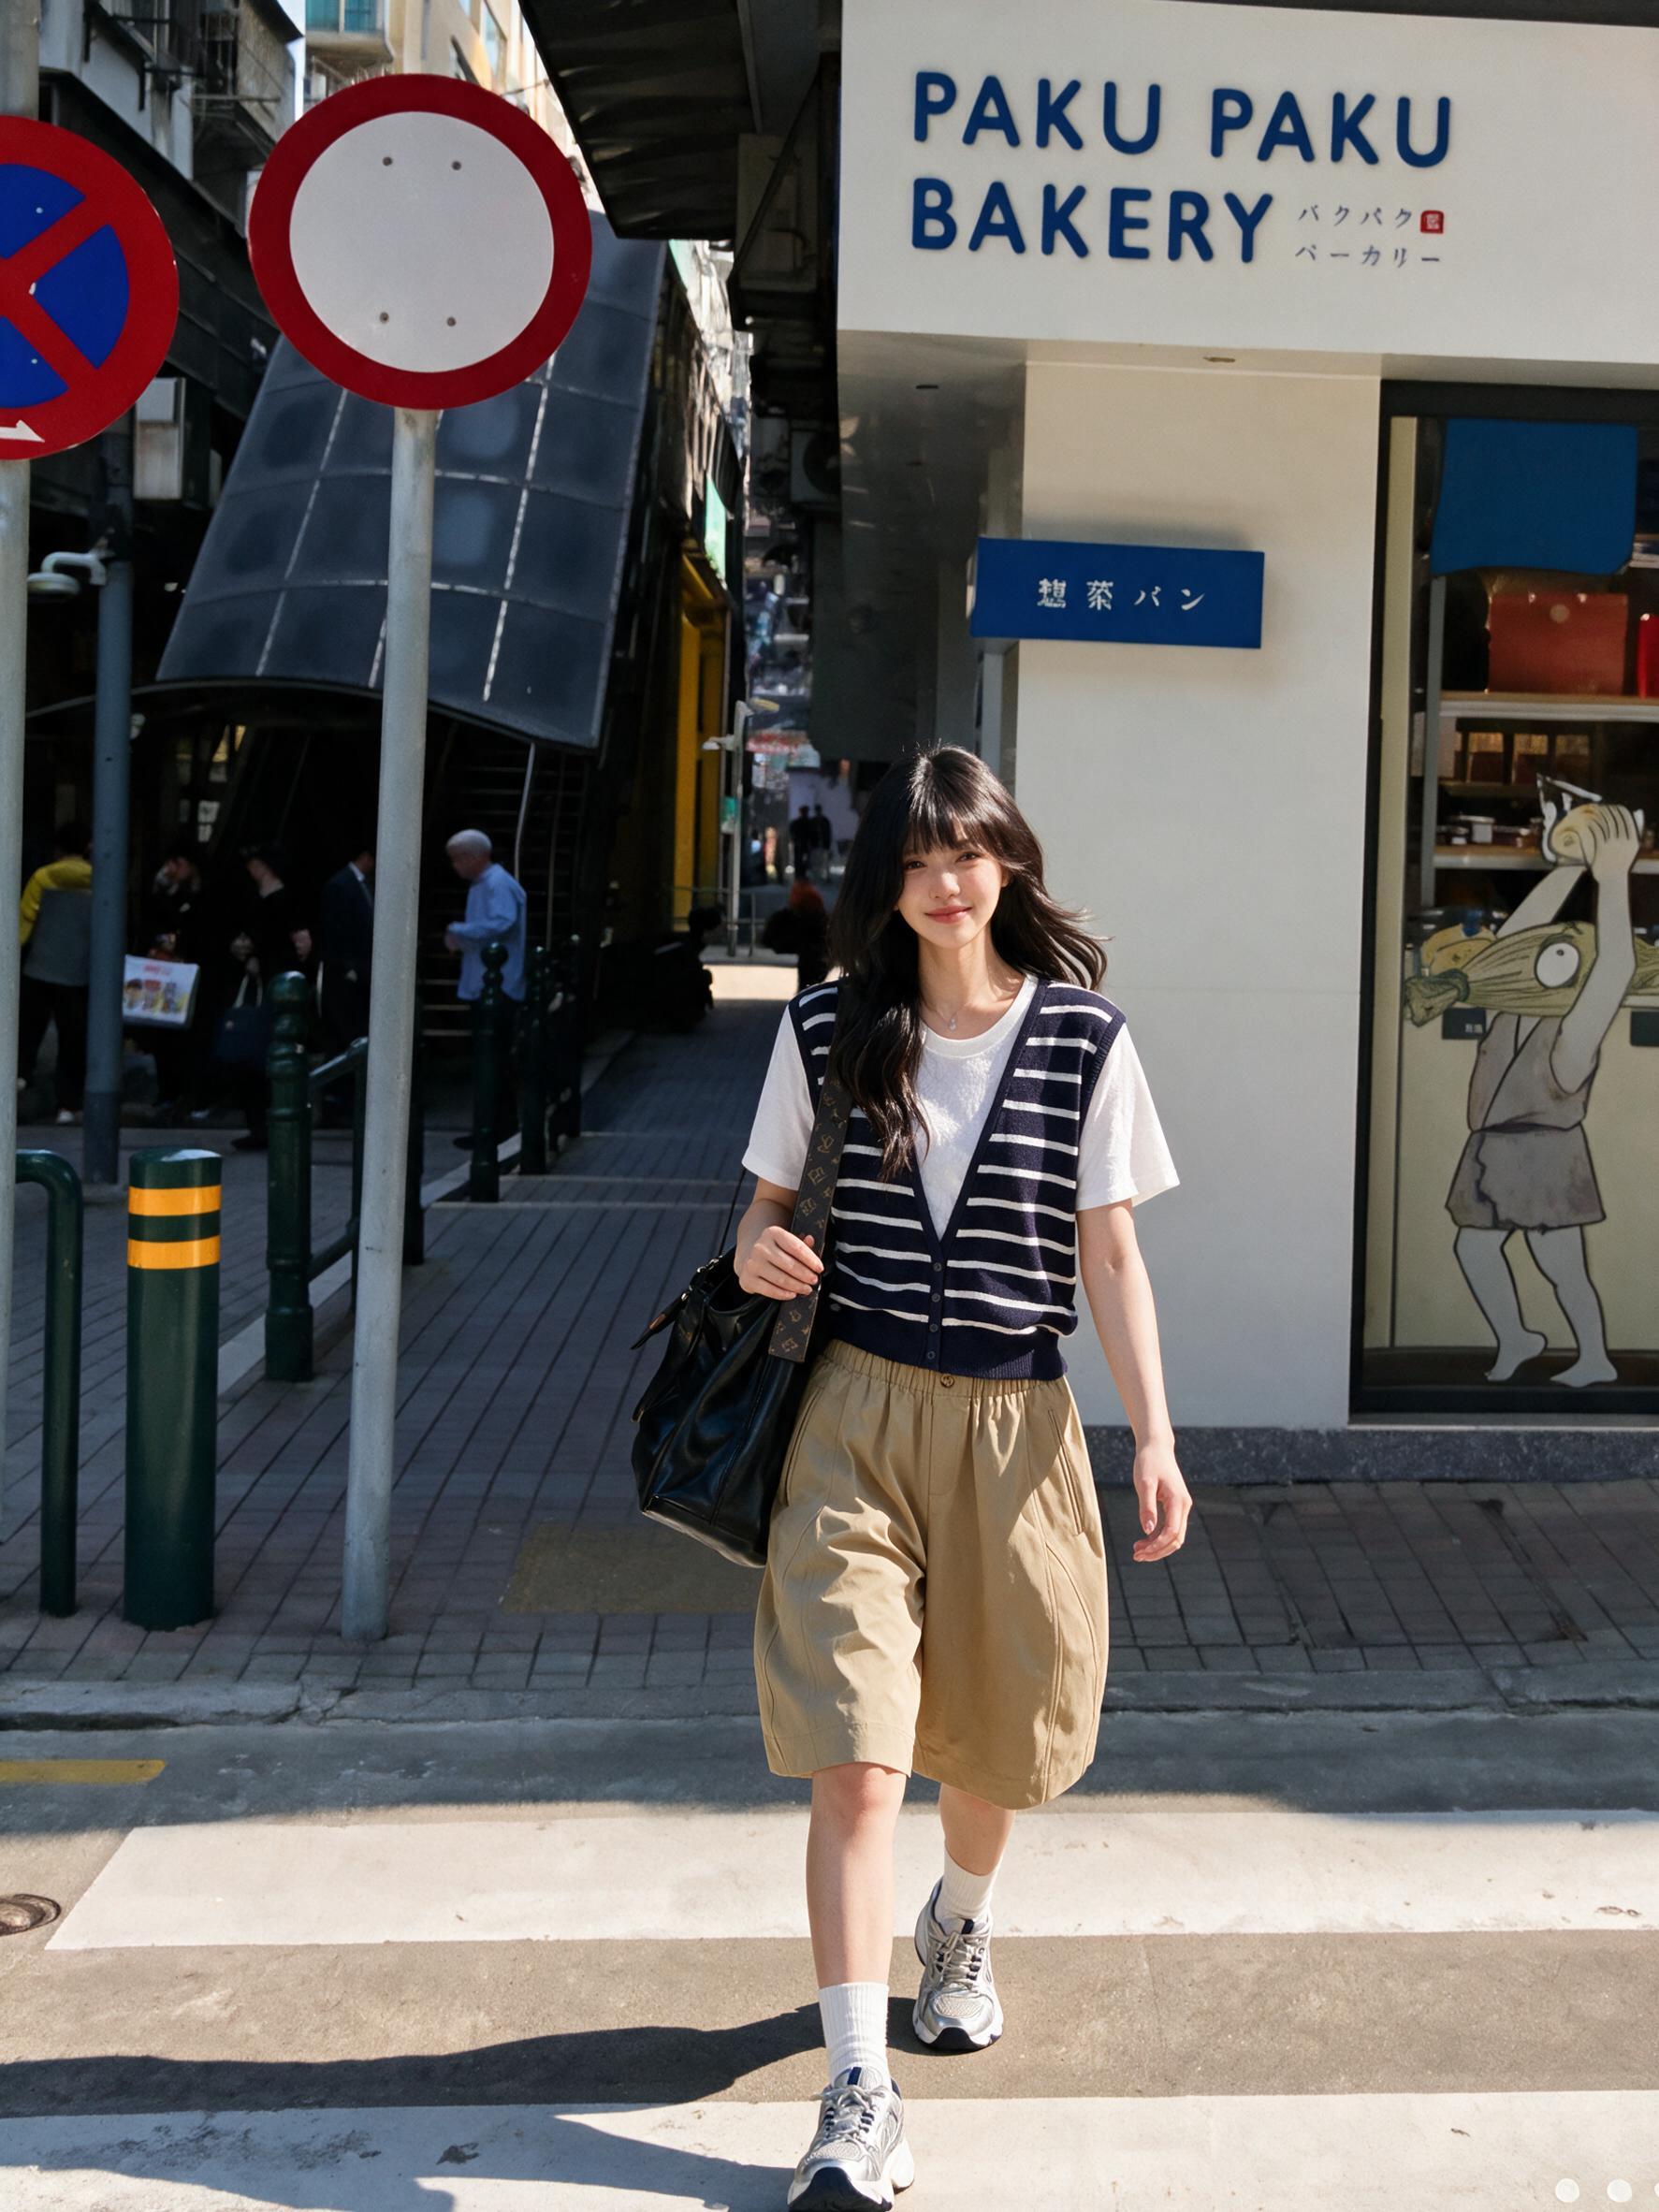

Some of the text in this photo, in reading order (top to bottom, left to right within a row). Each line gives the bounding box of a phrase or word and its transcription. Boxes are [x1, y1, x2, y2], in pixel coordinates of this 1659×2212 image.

[913, 70, 1451, 168] PAKU PAKU
[911, 177, 1273, 264] BAKERY
